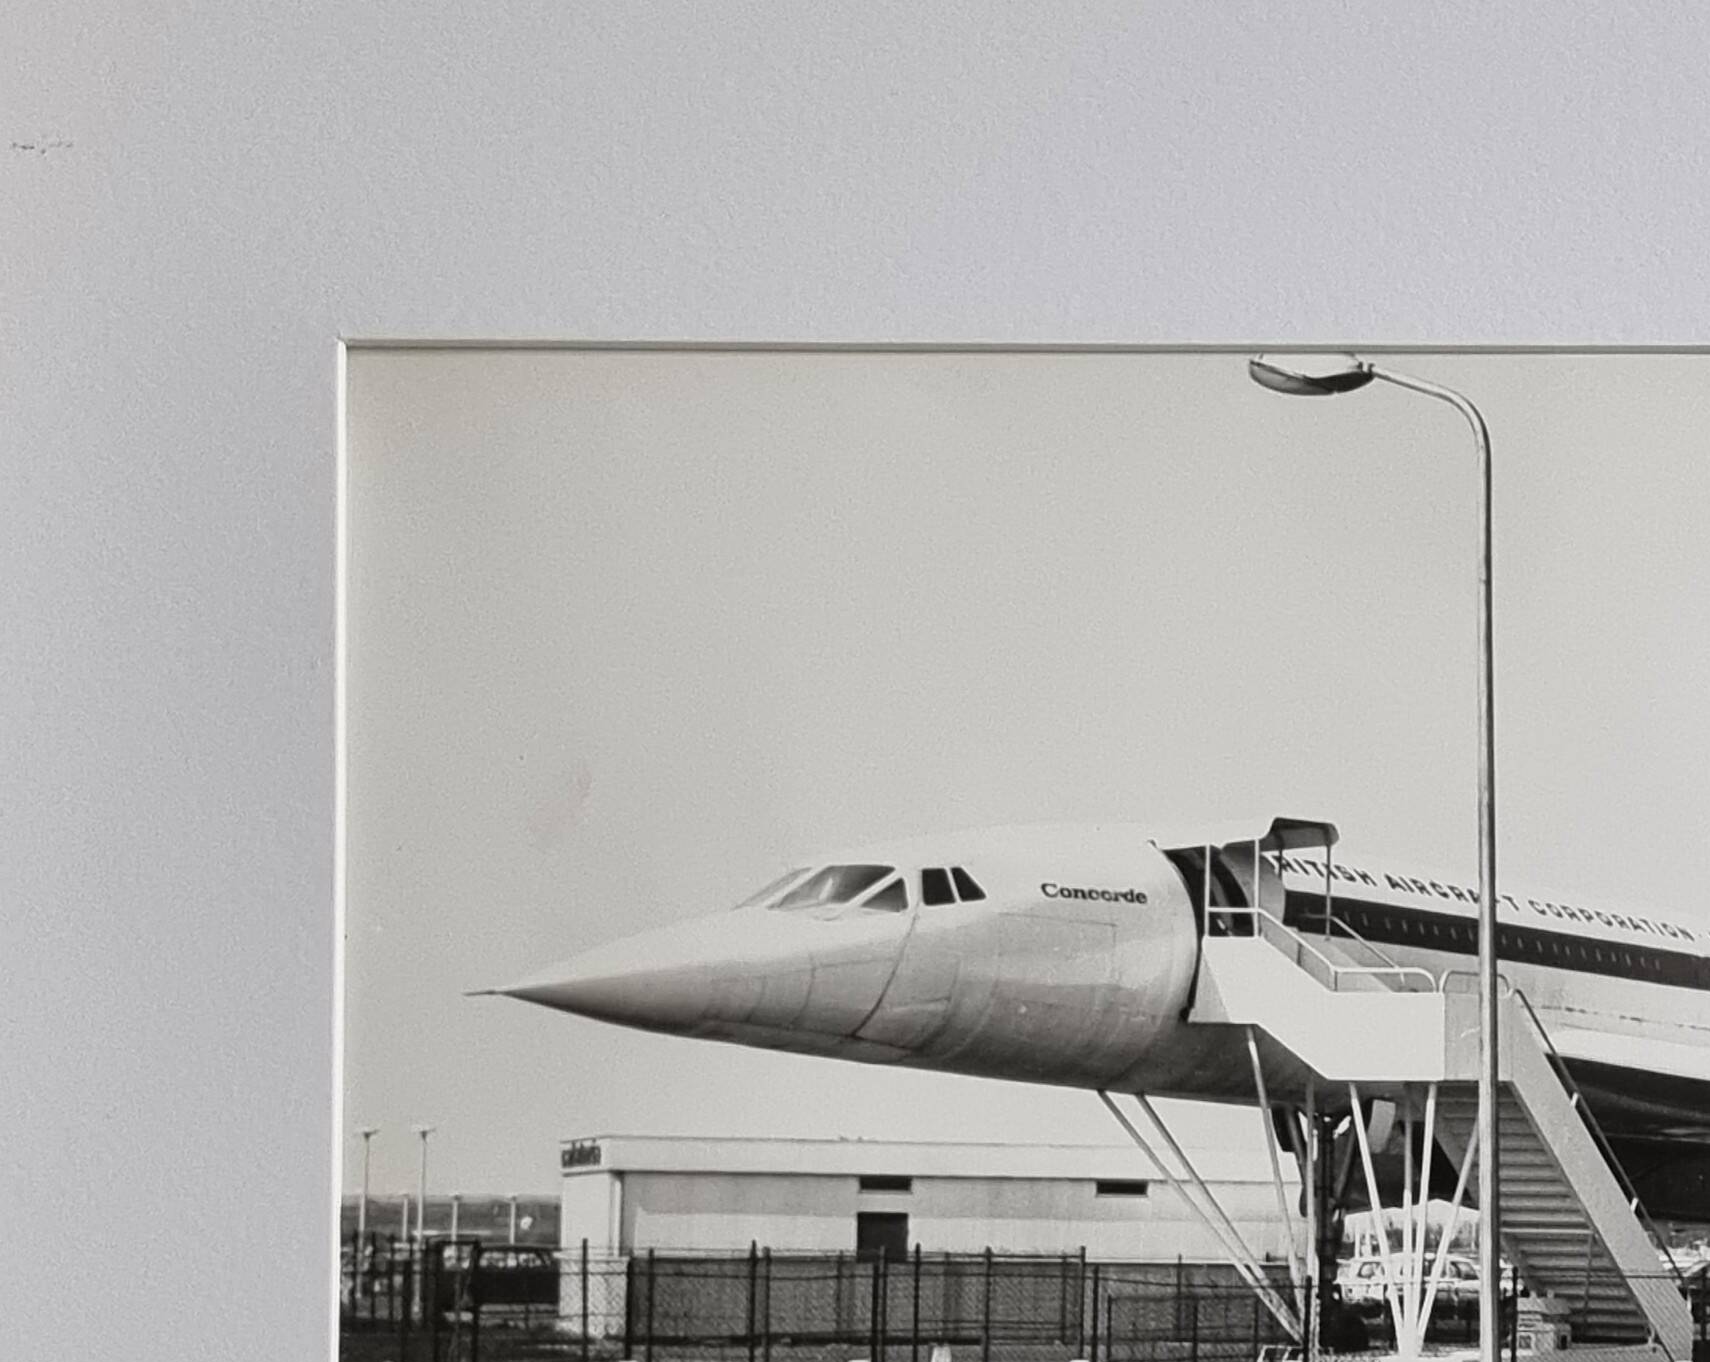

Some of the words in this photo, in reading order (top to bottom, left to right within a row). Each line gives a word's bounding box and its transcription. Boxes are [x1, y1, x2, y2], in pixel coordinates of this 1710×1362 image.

[1040, 882, 1148, 904] Concorde
[1271, 854, 1378, 887] RITISH
[1384, 873, 1520, 911] AIRCRAT
[1527, 899, 1695, 941] CORPORATION
